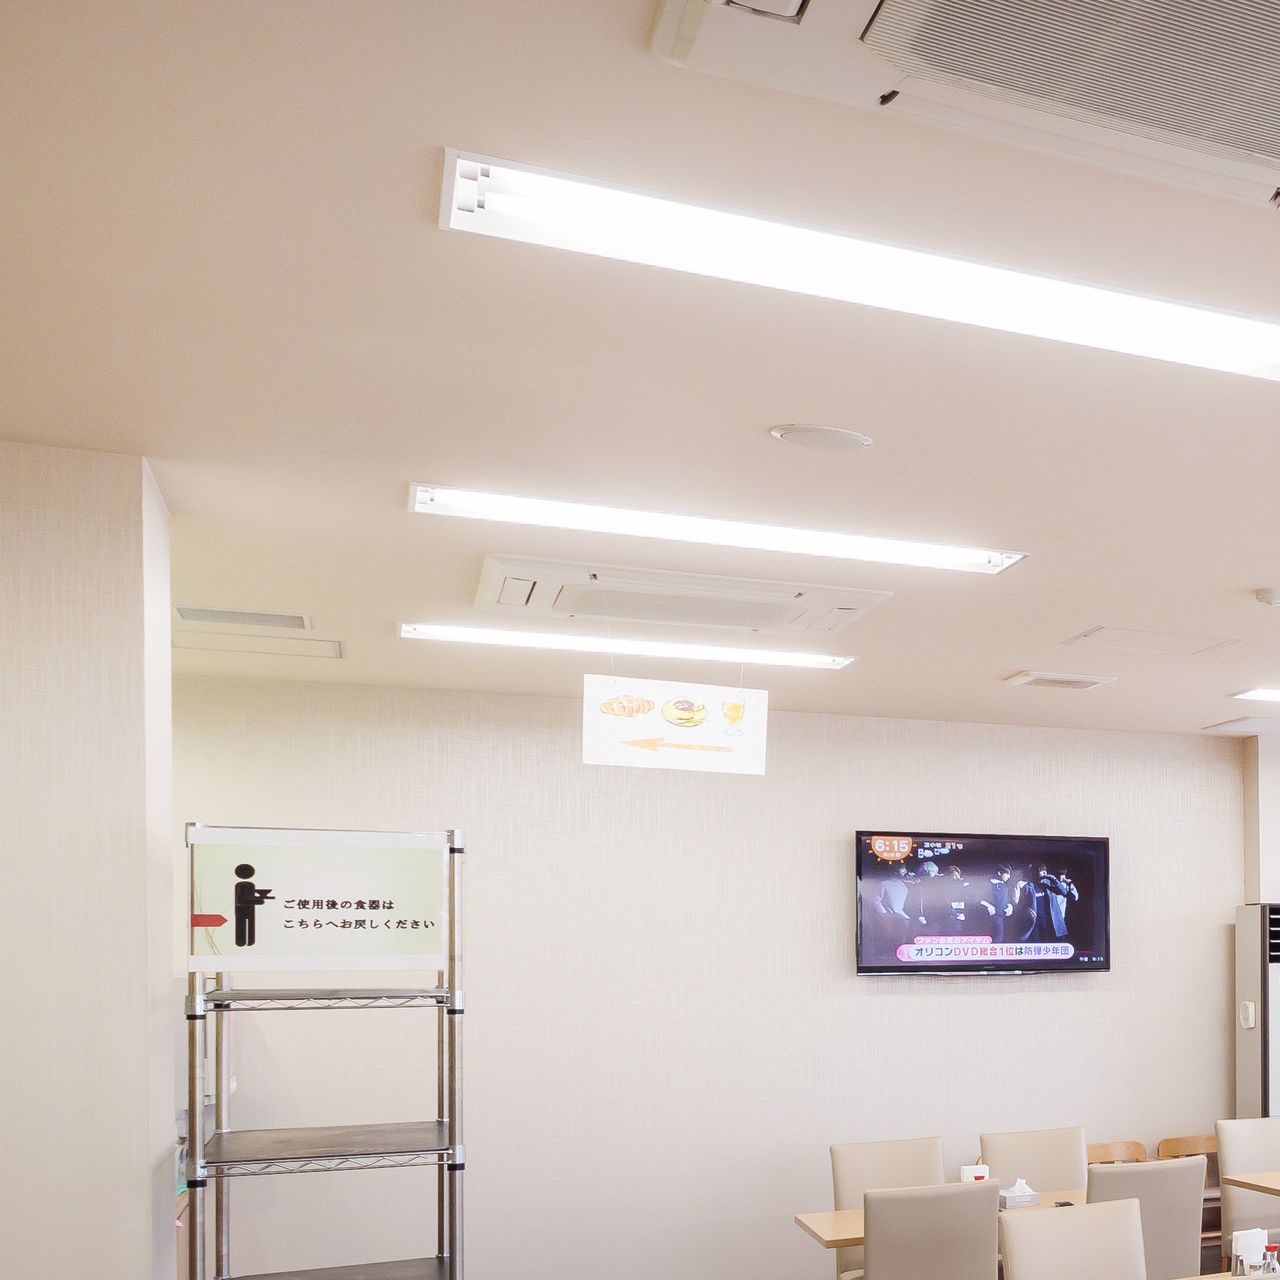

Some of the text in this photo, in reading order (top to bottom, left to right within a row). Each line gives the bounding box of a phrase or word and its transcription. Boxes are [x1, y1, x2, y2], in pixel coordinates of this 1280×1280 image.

[875, 839, 909, 852] 6:15
[283, 898, 395, 911] ご使用後の食器は
[283, 918, 436, 930] こちらへお戻しください
[914, 945, 1070, 957] オリコンDVD総合1位は防弾少年団
